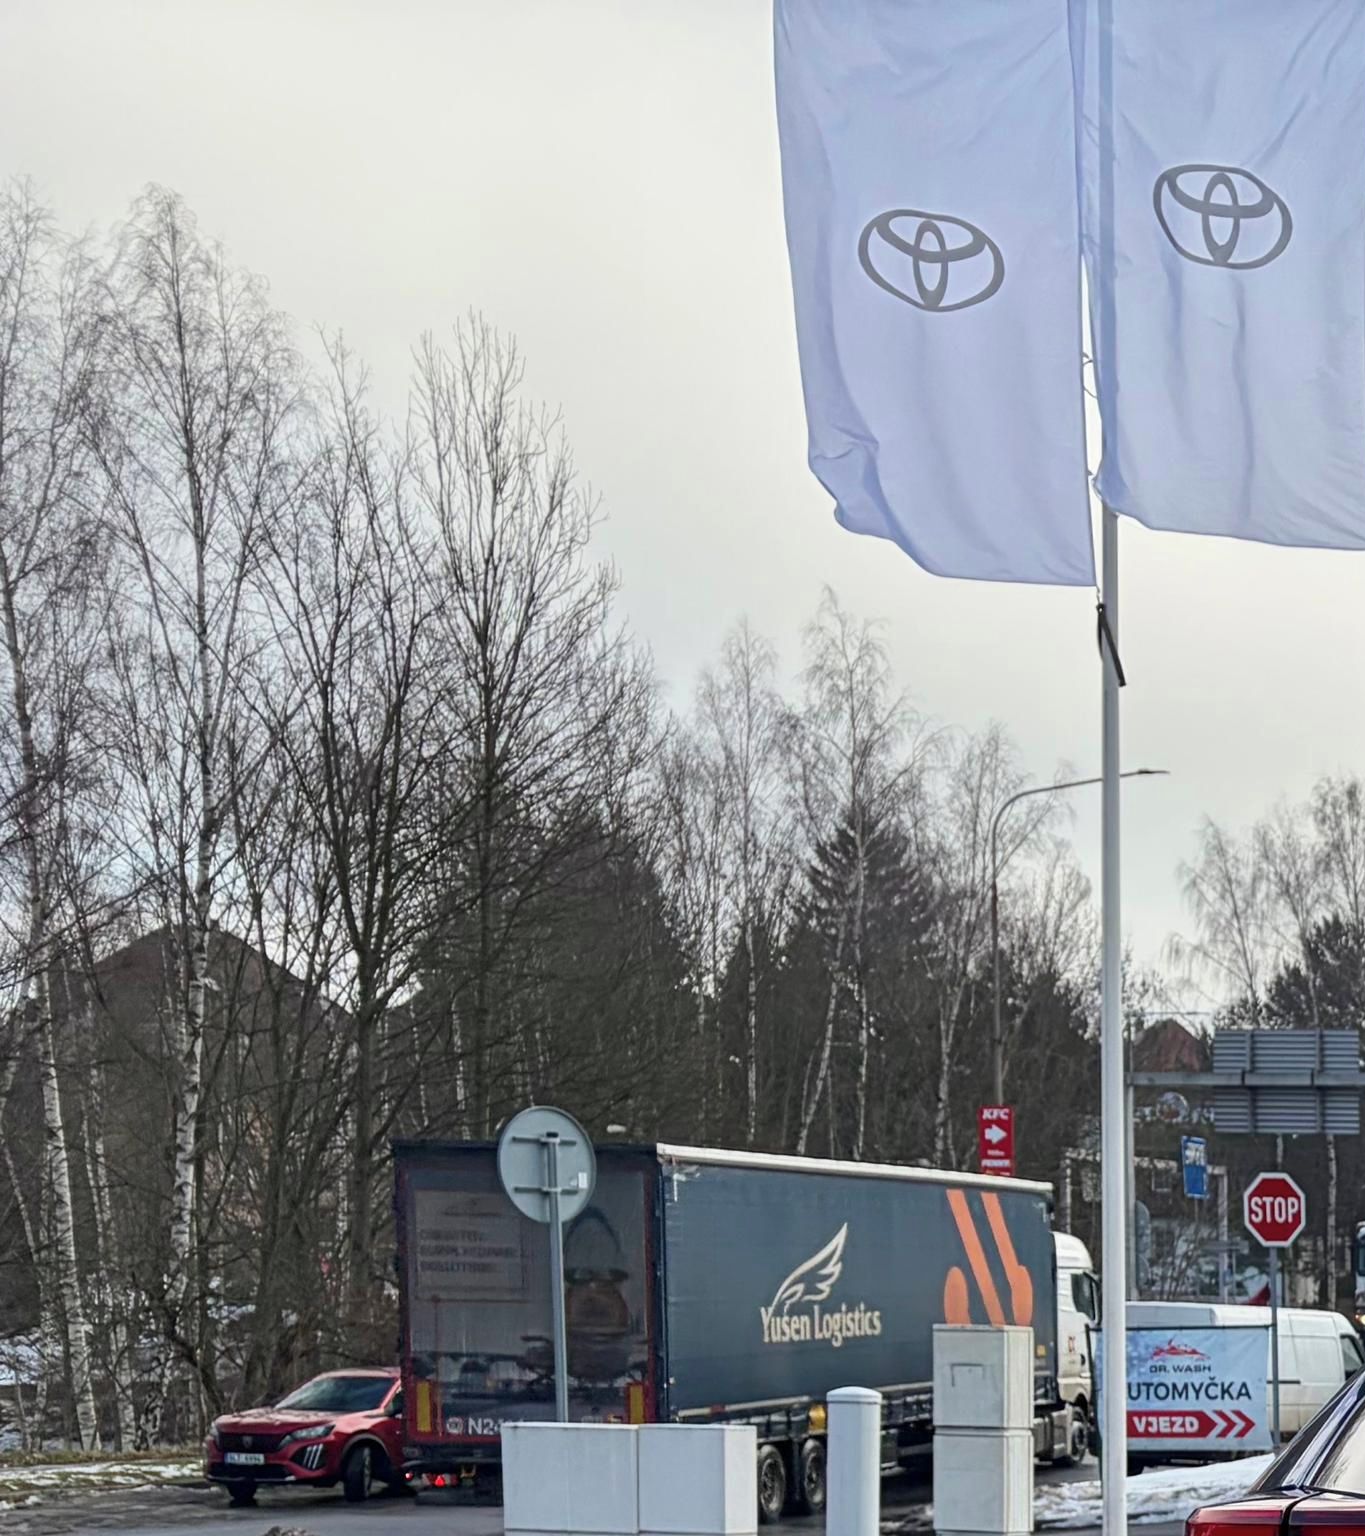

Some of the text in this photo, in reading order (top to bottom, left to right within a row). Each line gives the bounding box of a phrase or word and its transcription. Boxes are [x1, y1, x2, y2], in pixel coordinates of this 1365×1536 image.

[982, 1108, 1010, 1120] KFC
[1250, 1196, 1299, 1223] STOP
[760, 1301, 882, 1347] Yusen Logistics
[1172, 1364, 1212, 1374] WASH
[1127, 1376, 1252, 1401] UTOMYČKA
[1132, 1416, 1199, 1434] VJEZD
